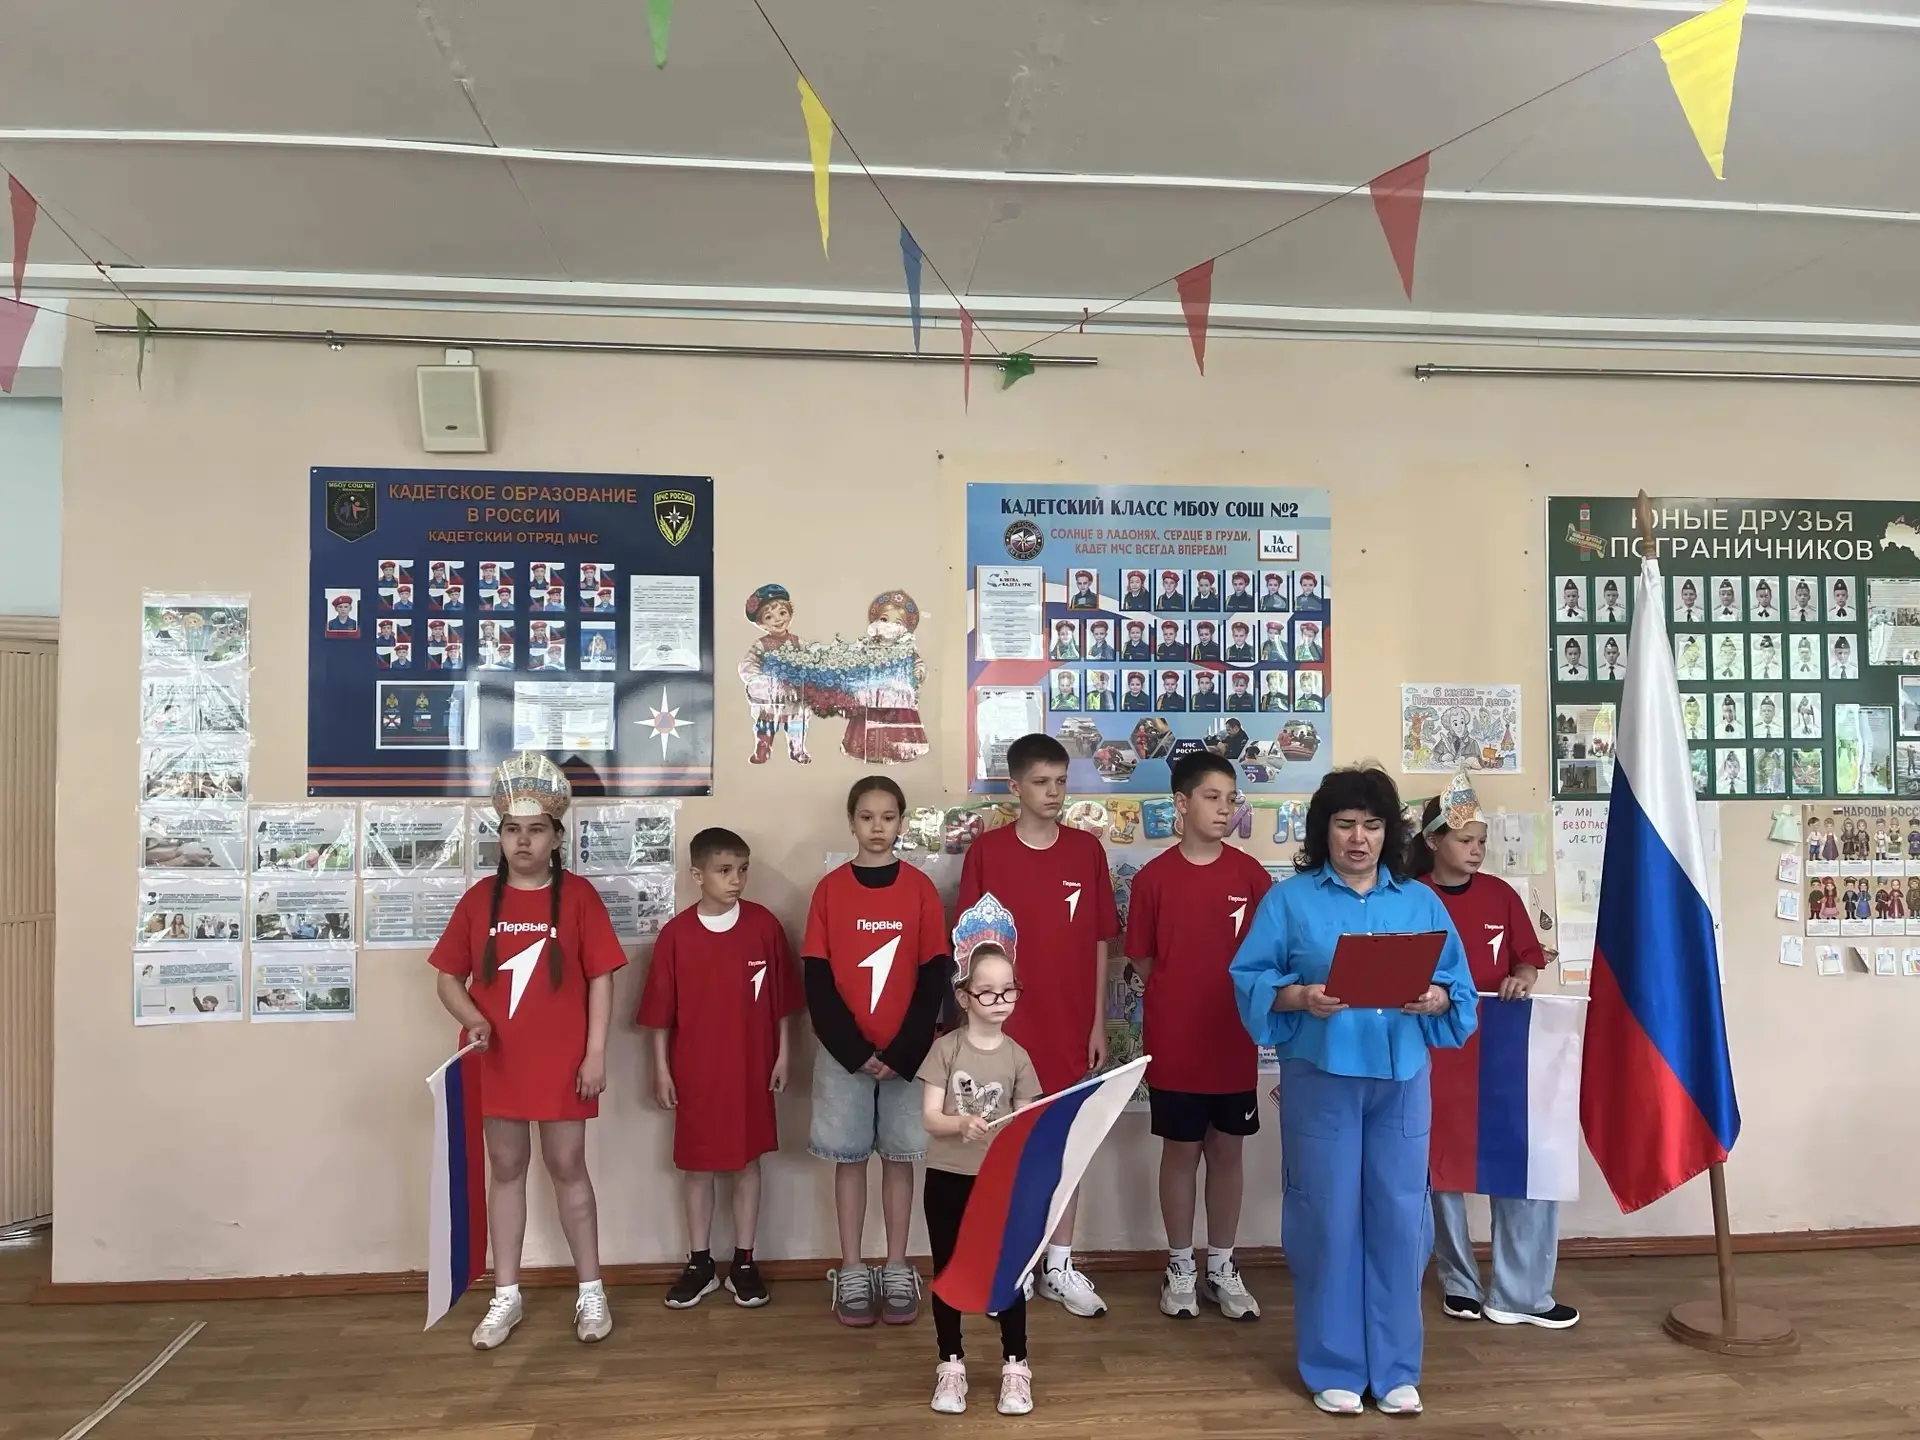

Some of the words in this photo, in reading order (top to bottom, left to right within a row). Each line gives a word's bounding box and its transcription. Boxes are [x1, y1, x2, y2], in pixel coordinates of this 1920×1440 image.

[388, 484, 496, 501] КАДЕТСКОЕ
[501, 485, 638, 504] ОБРАЗОВАНИЕ
[1001, 496, 1104, 517] КАДЕТСКИЙ
[1111, 500, 1168, 517] КЛАСС
[1173, 500, 1220, 517] МБОУ
[1225, 501, 1264, 518] СОШ
[1270, 502, 1299, 518] №2
[467, 507, 479, 522] В
[485, 508, 560, 524] РОССИИ
[1738, 509, 1853, 535] ДРУЗЬЯ
[428, 529, 512, 543] КАДЕТСКИЙ
[516, 532, 564, 545] ОТРЯД
[568, 533, 599, 544] МЧС
[1050, 528, 1094, 542] СОЛНЦЕ
[1096, 529, 1104, 540] В
[1163, 530, 1203, 543] СЕРДЦЕ
[1206, 530, 1213, 541] В
[1075, 544, 1108, 555] КАДЕТ
[1110, 544, 1132, 555] МЧС
[1135, 544, 1175, 555] ВСЕГДА
[1178, 544, 1227, 556] ВПЕРЕДИ!
[1263, 545, 1294, 553] КЛАСС
[1433, 687, 1442, 696] 6
[1444, 688, 1475, 697] июня
[1412, 694, 1484, 706] Пушкинский
[1485, 698, 1512, 706] день
[1843, 805, 1887, 818] НАРОДЫ
[1890, 806, 1920, 818] РОСС
[369, 823, 378, 836] 5
[478, 822, 487, 834] 6
[580, 820, 589, 834] 7
[580, 835, 589, 849] 8
[580, 851, 589, 864] 9
[497, 921, 549, 936] Первые
[856, 918, 903, 934] Первые
